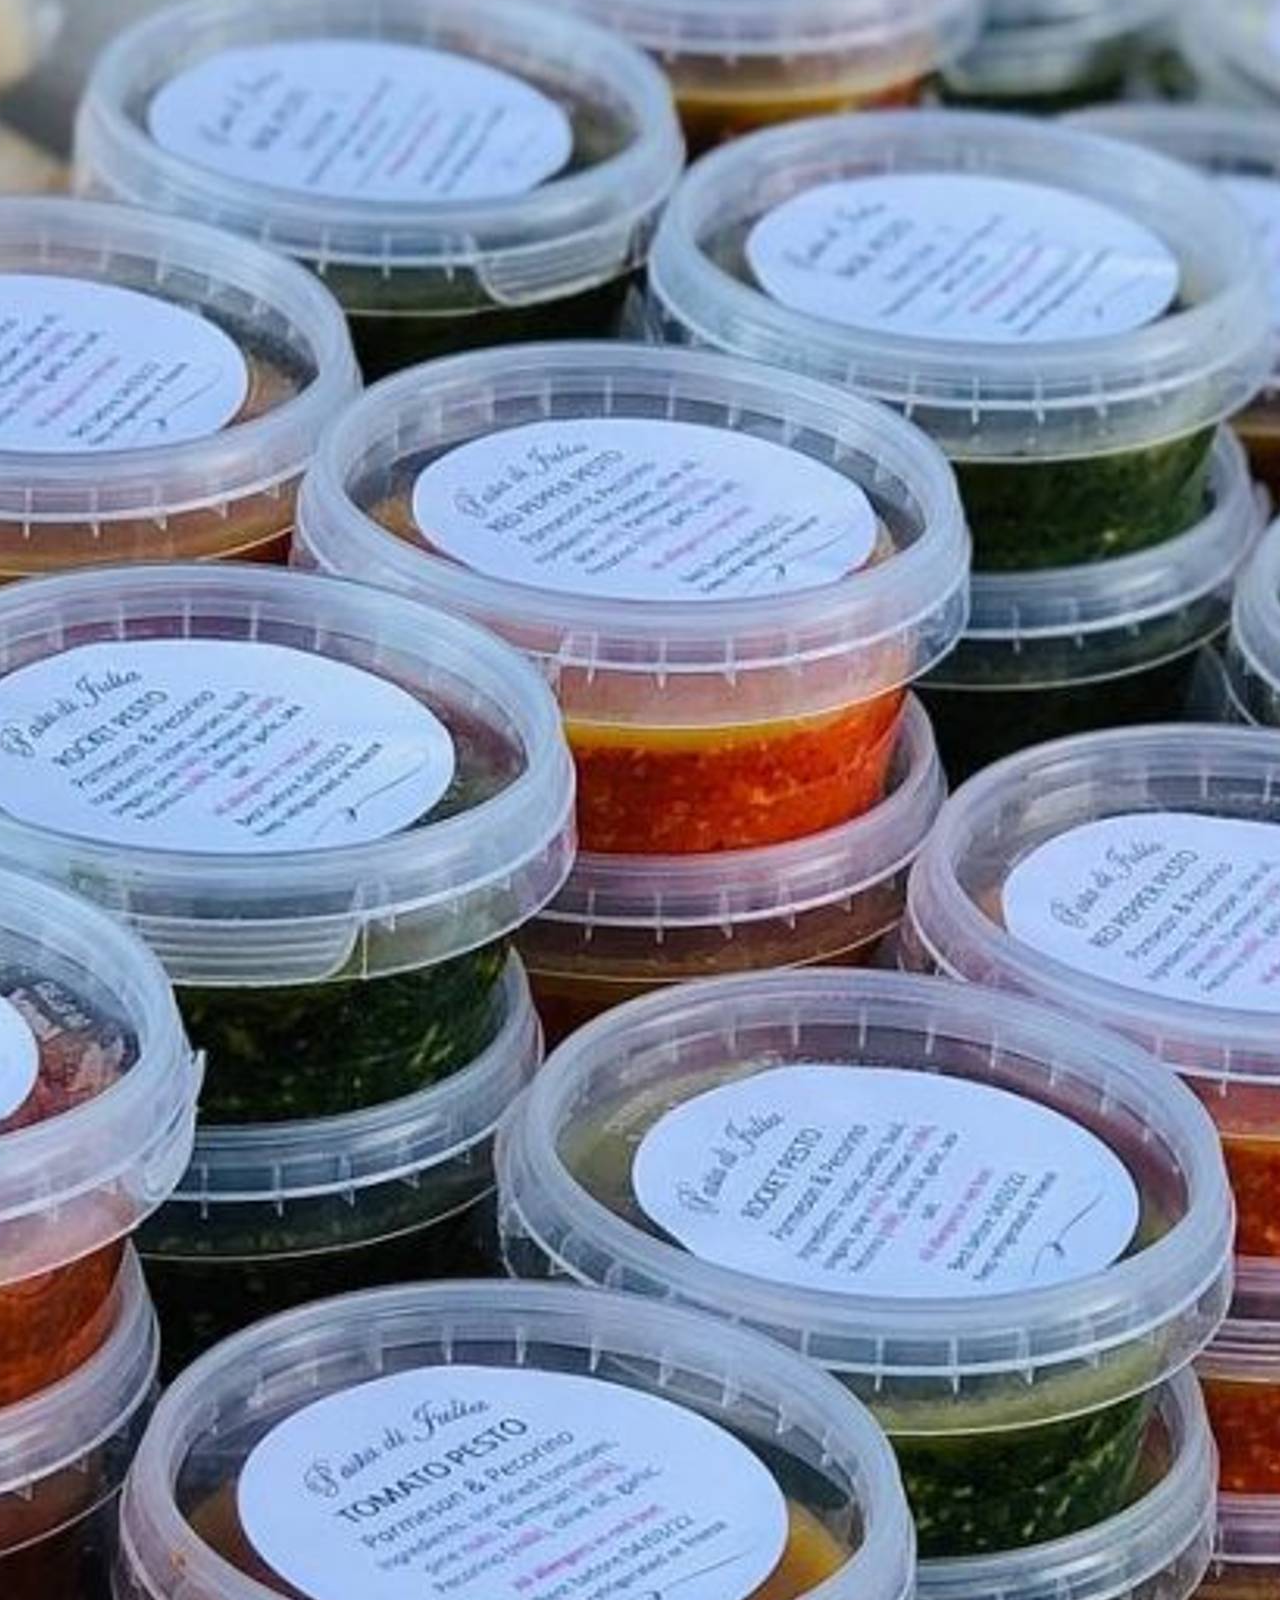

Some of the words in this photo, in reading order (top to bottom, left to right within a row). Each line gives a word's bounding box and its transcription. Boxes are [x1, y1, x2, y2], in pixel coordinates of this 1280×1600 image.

[567, 449, 626, 483] PESTO
[50, 724, 120, 768] ROCKET
[108, 689, 170, 729] PESTO
[1087, 925, 1124, 948] RED
[1110, 884, 1166, 928] PEPPER
[1151, 849, 1200, 886] PESTO
[740, 1168, 792, 1220] ROCKET
[776, 1128, 824, 1170] PESTO
[808, 1174, 833, 1187] &
[335, 1461, 453, 1523] TOMATO
[442, 1417, 530, 1466] PESTO
[359, 1491, 468, 1549] Parmesan
[459, 1478, 489, 1495] &
[481, 1430, 577, 1483] Pecorino
